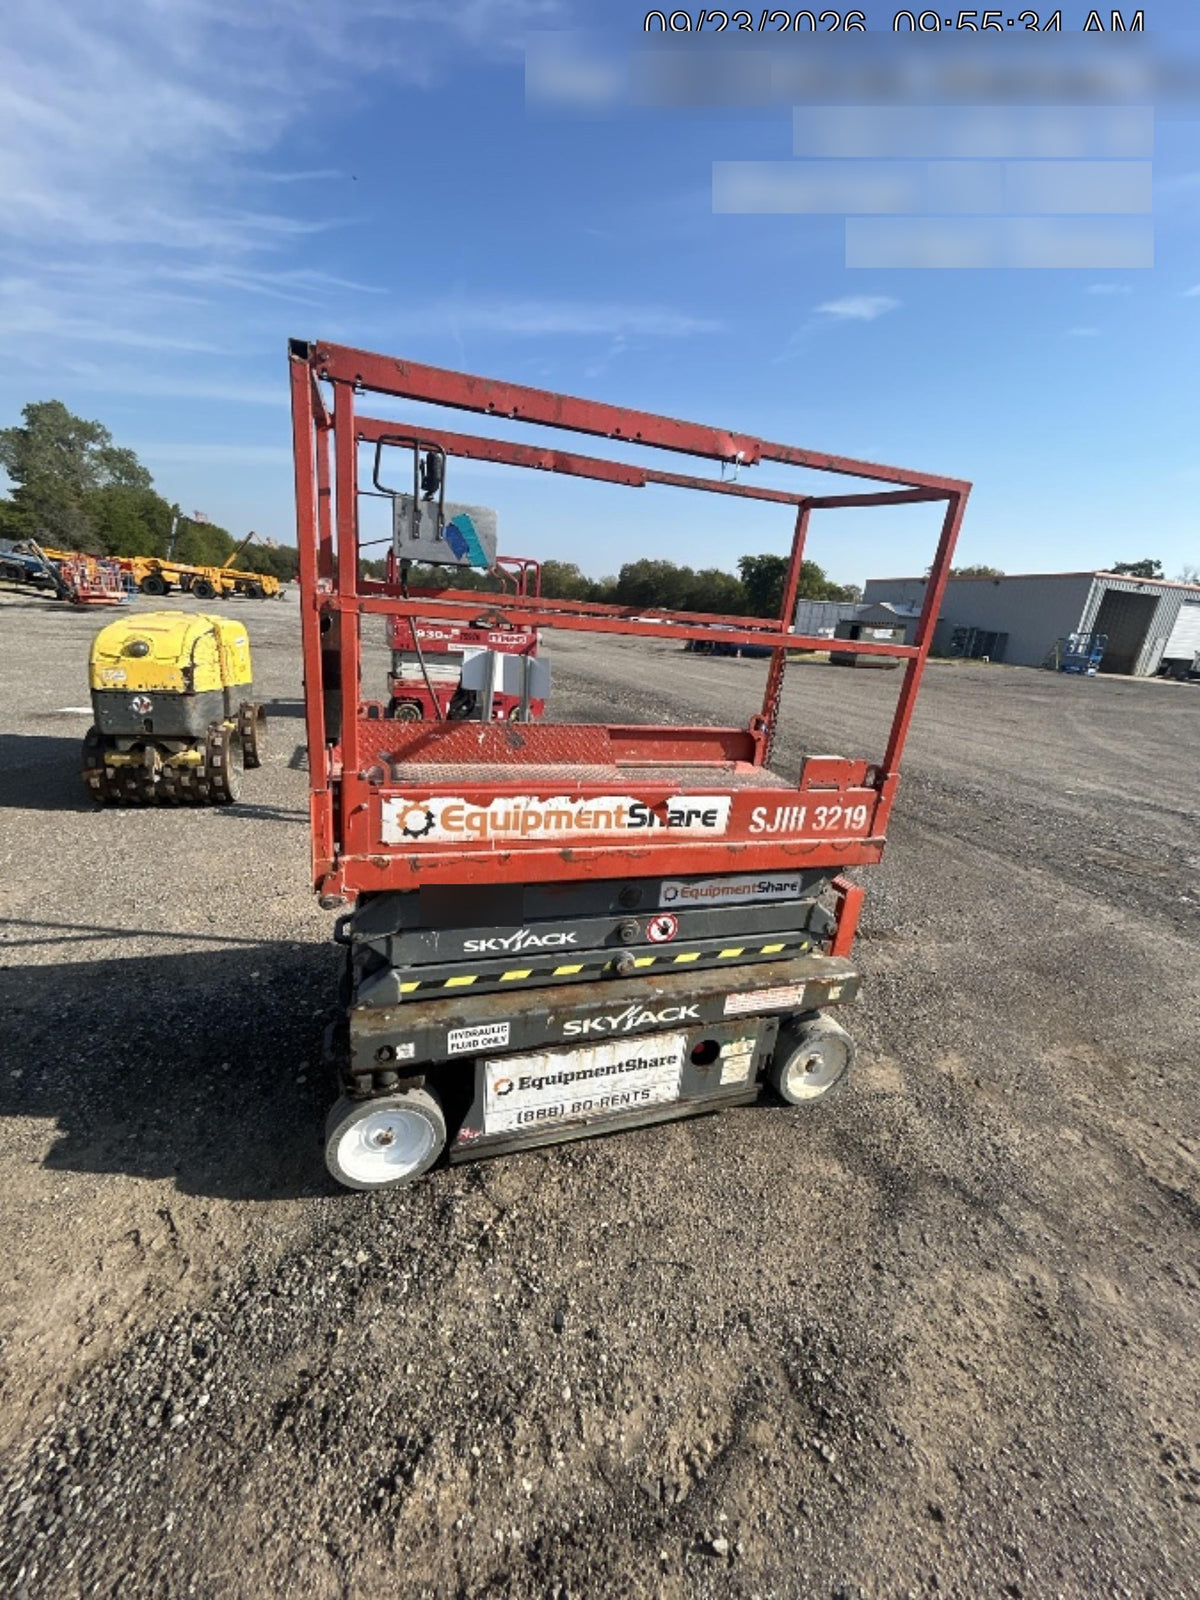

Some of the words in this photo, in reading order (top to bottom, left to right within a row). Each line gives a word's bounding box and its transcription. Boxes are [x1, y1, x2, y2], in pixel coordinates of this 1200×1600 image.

[812, 805, 868, 831] 3219
[680, 880, 799, 900] EquipmentShare
[463, 928, 578, 952] SKYJACK
[563, 1003, 701, 1036] SKYJACK
[450, 1025, 508, 1041] HYDRAULIC
[451, 1039, 479, 1052] FLUID
[481, 1034, 508, 1047] ONLY
[518, 1053, 678, 1091] EquipmentShare
[517, 1103, 565, 1124] (888)
